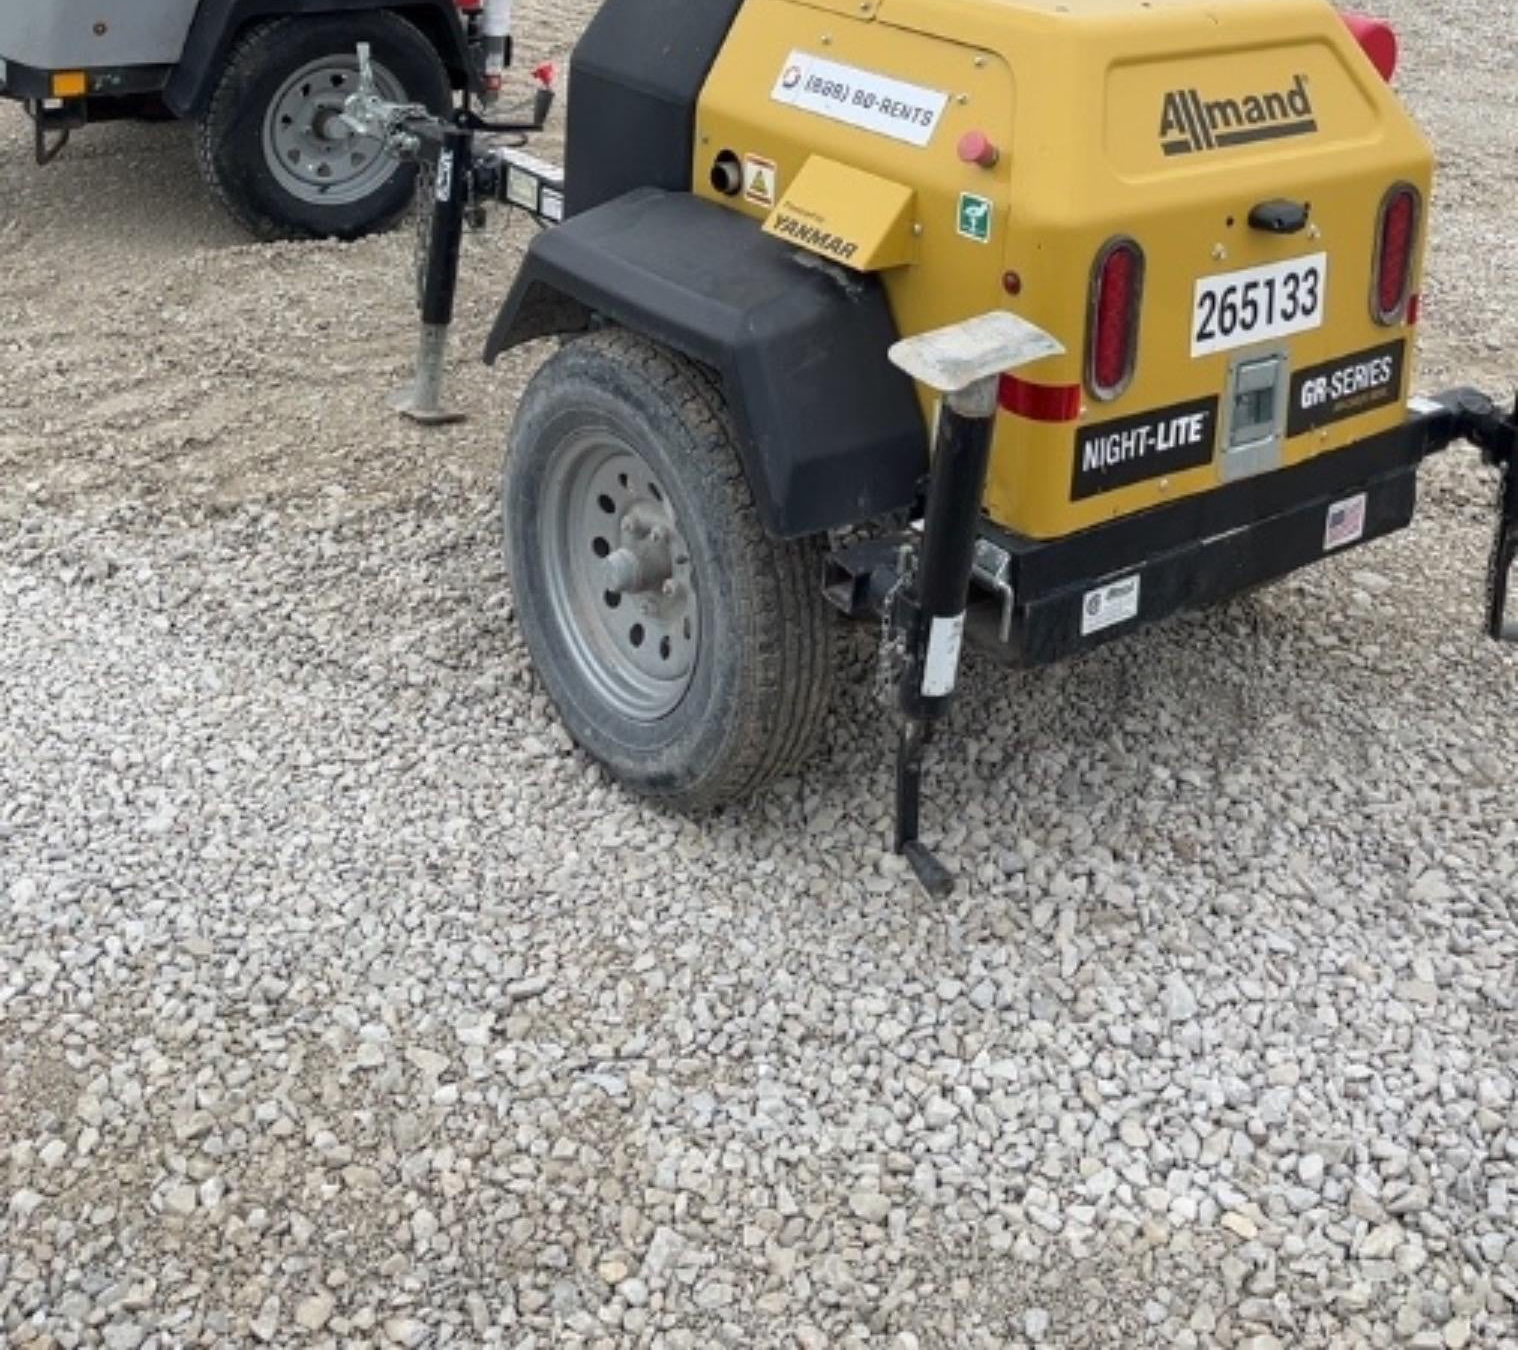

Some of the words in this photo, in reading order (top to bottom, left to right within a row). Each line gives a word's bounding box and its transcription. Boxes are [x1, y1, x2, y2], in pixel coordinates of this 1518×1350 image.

[1160, 74, 1313, 151] Allmand
[773, 212, 860, 259] YANMAR
[1196, 267, 1319, 342] 265133
[1300, 356, 1393, 410] GR-SERIES
